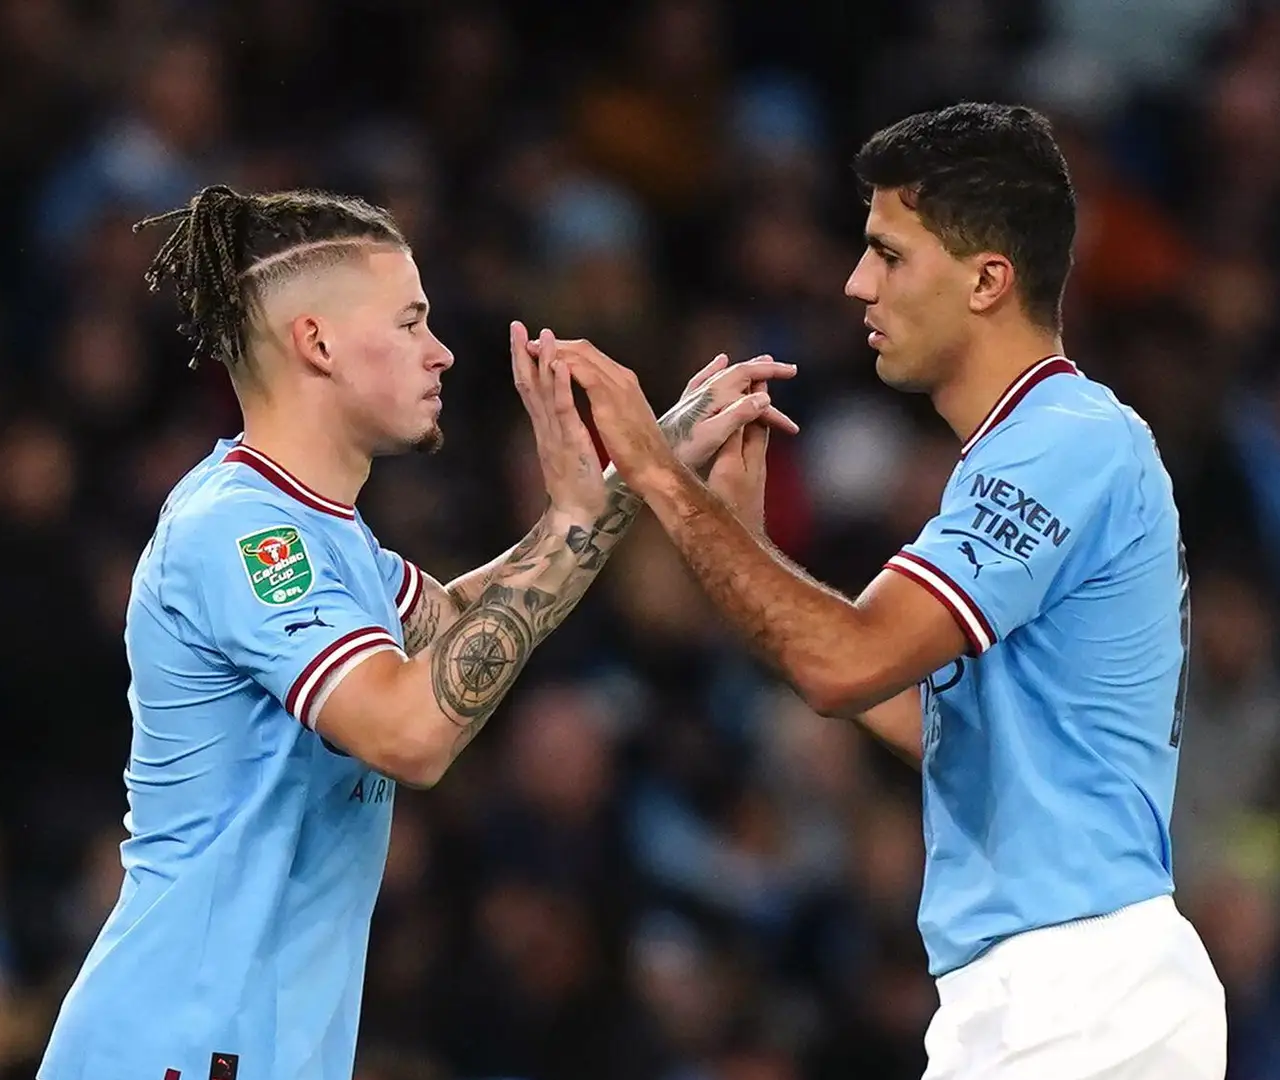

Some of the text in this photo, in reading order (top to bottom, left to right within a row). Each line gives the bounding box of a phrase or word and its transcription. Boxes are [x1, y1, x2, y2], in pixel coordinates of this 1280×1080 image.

[969, 473, 1071, 548] NEXEN
[970, 502, 1040, 560] TIRE
[252, 552, 305, 584] Carabao
[269, 568, 294, 586] Cup
